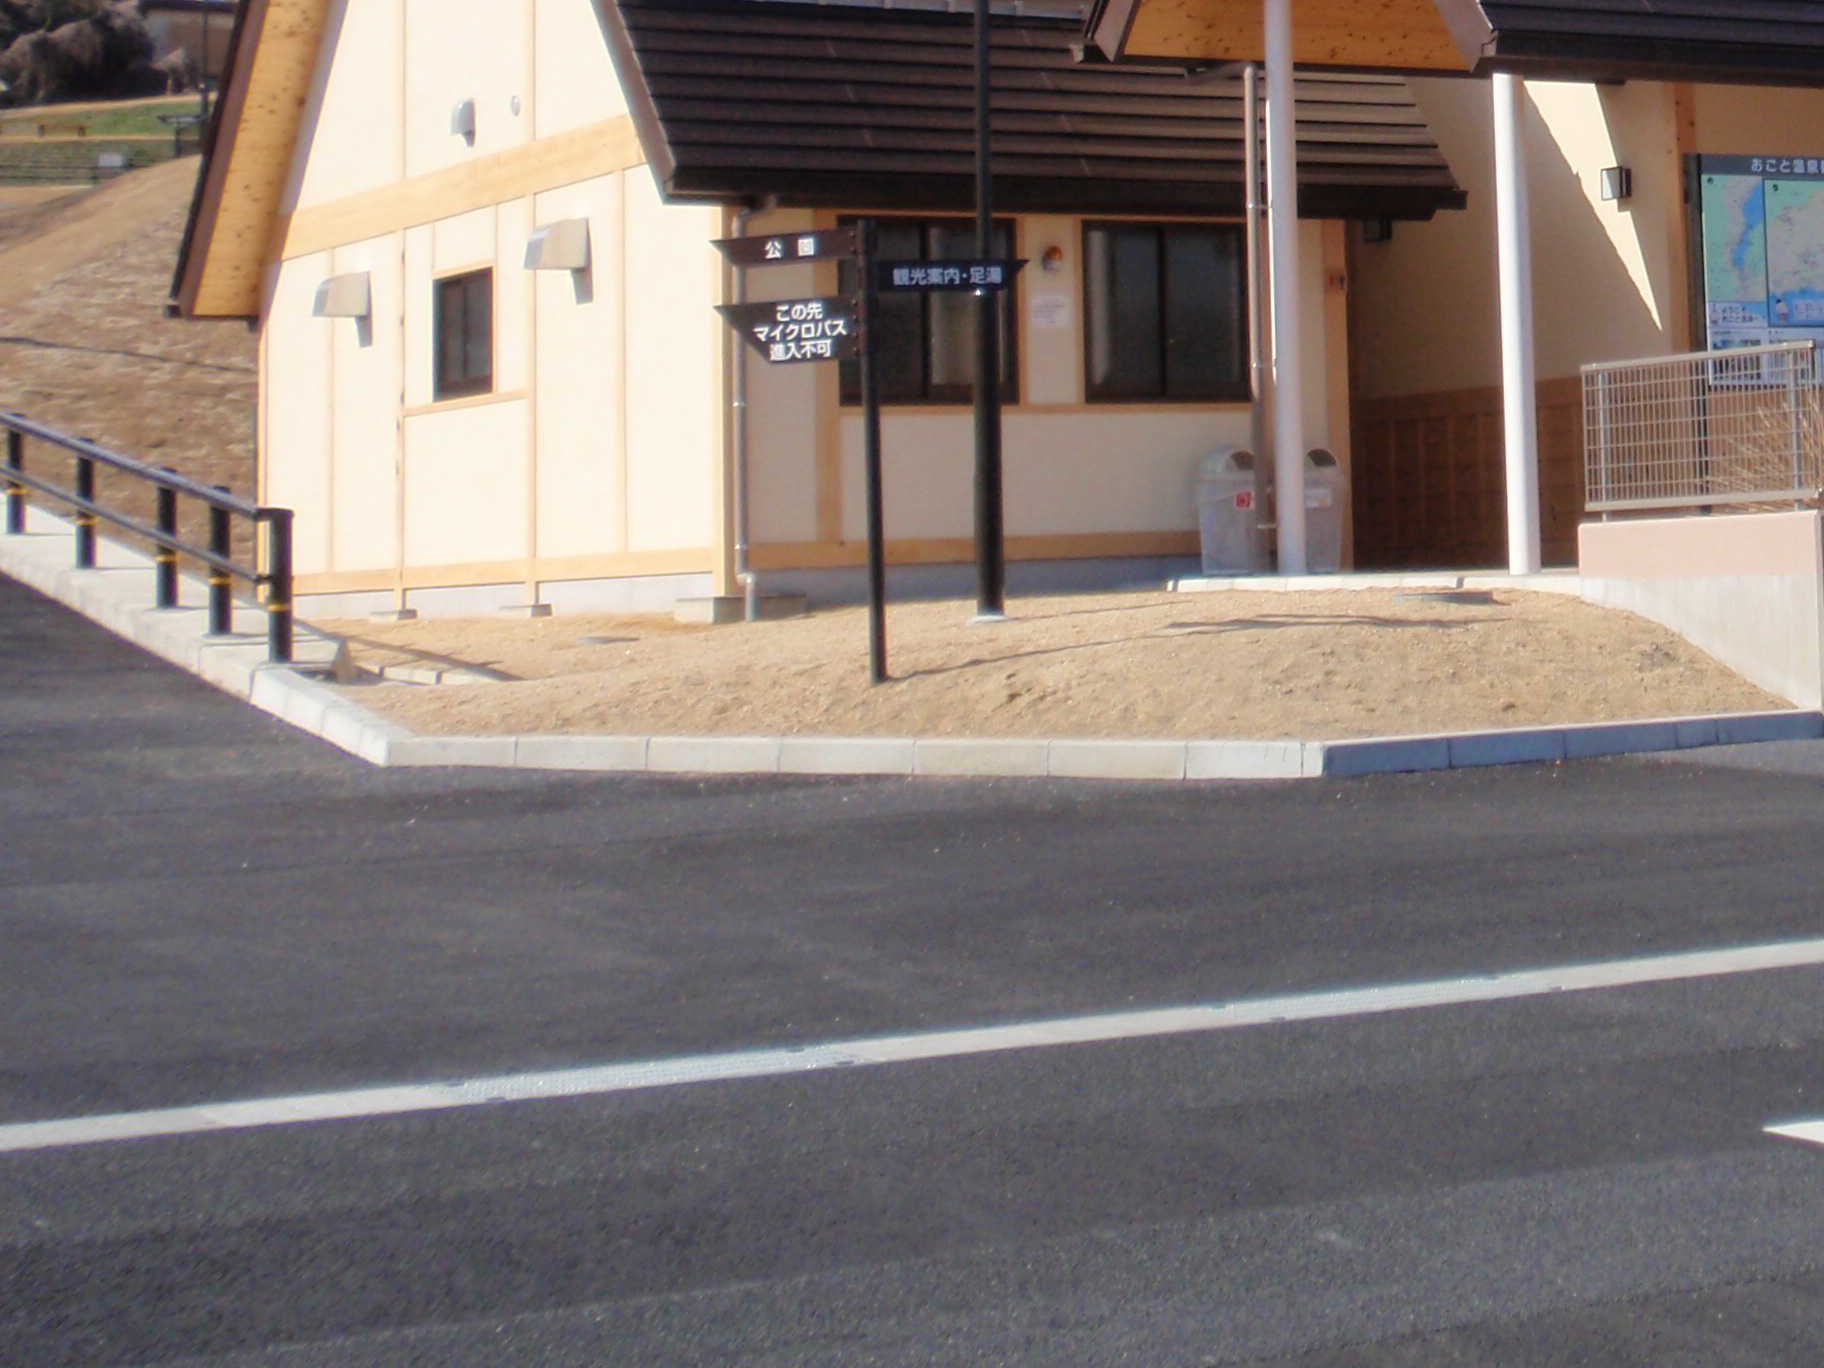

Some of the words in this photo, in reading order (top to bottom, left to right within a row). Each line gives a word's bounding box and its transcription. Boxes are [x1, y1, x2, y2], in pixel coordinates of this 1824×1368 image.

[892, 266, 1004, 286] 観光案内・足湯
[775, 301, 824, 322] この先
[752, 319, 848, 343] マイクロバス
[769, 338, 833, 362] 進入不可
